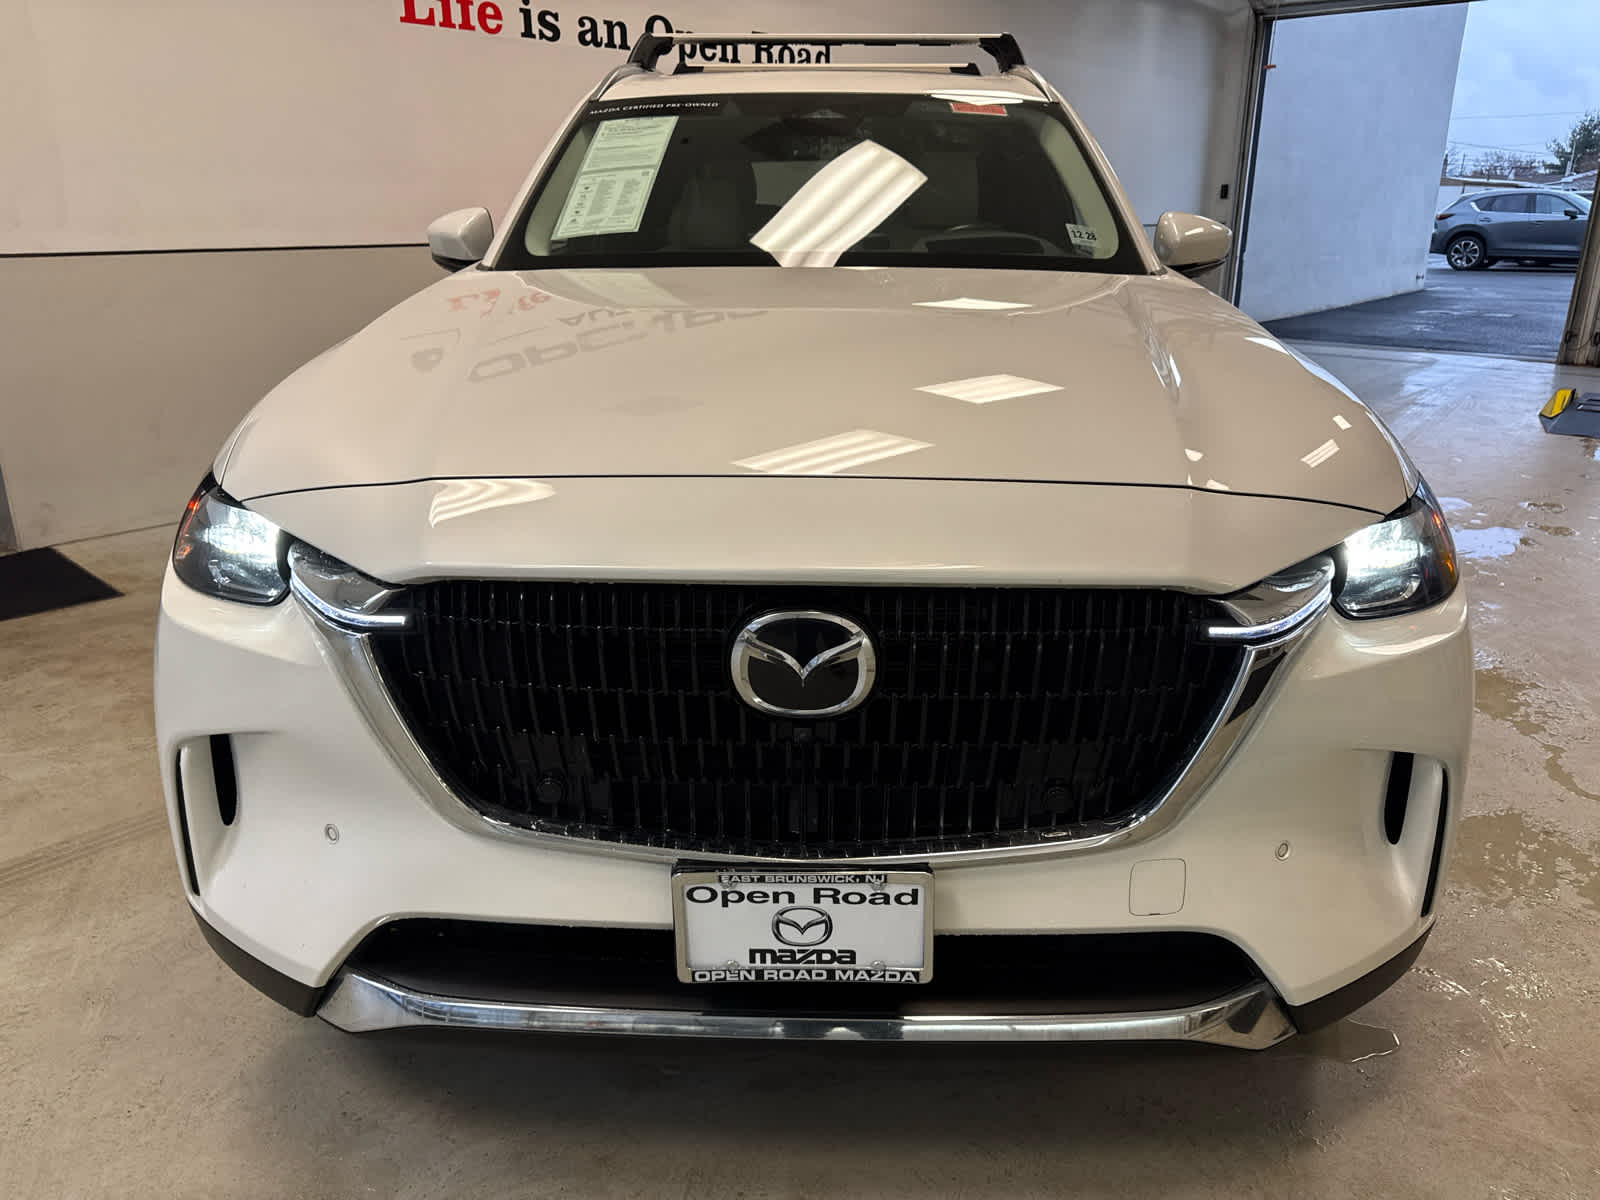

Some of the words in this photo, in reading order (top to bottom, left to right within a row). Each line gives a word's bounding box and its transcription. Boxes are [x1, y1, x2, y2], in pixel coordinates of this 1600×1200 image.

[519, 0, 561, 42] is
[577, 15, 631, 51] an
[590, 107, 620, 115] MAZDA
[622, 103, 664, 111] CERTIFIED
[721, 874, 761, 884] EAST
[865, 874, 886, 884] NJ
[686, 886, 796, 908] Open
[813, 887, 919, 906] Road
[694, 969, 756, 982] OPEN
[764, 969, 828, 982] ROAD
[835, 970, 918, 983] MAZDA
